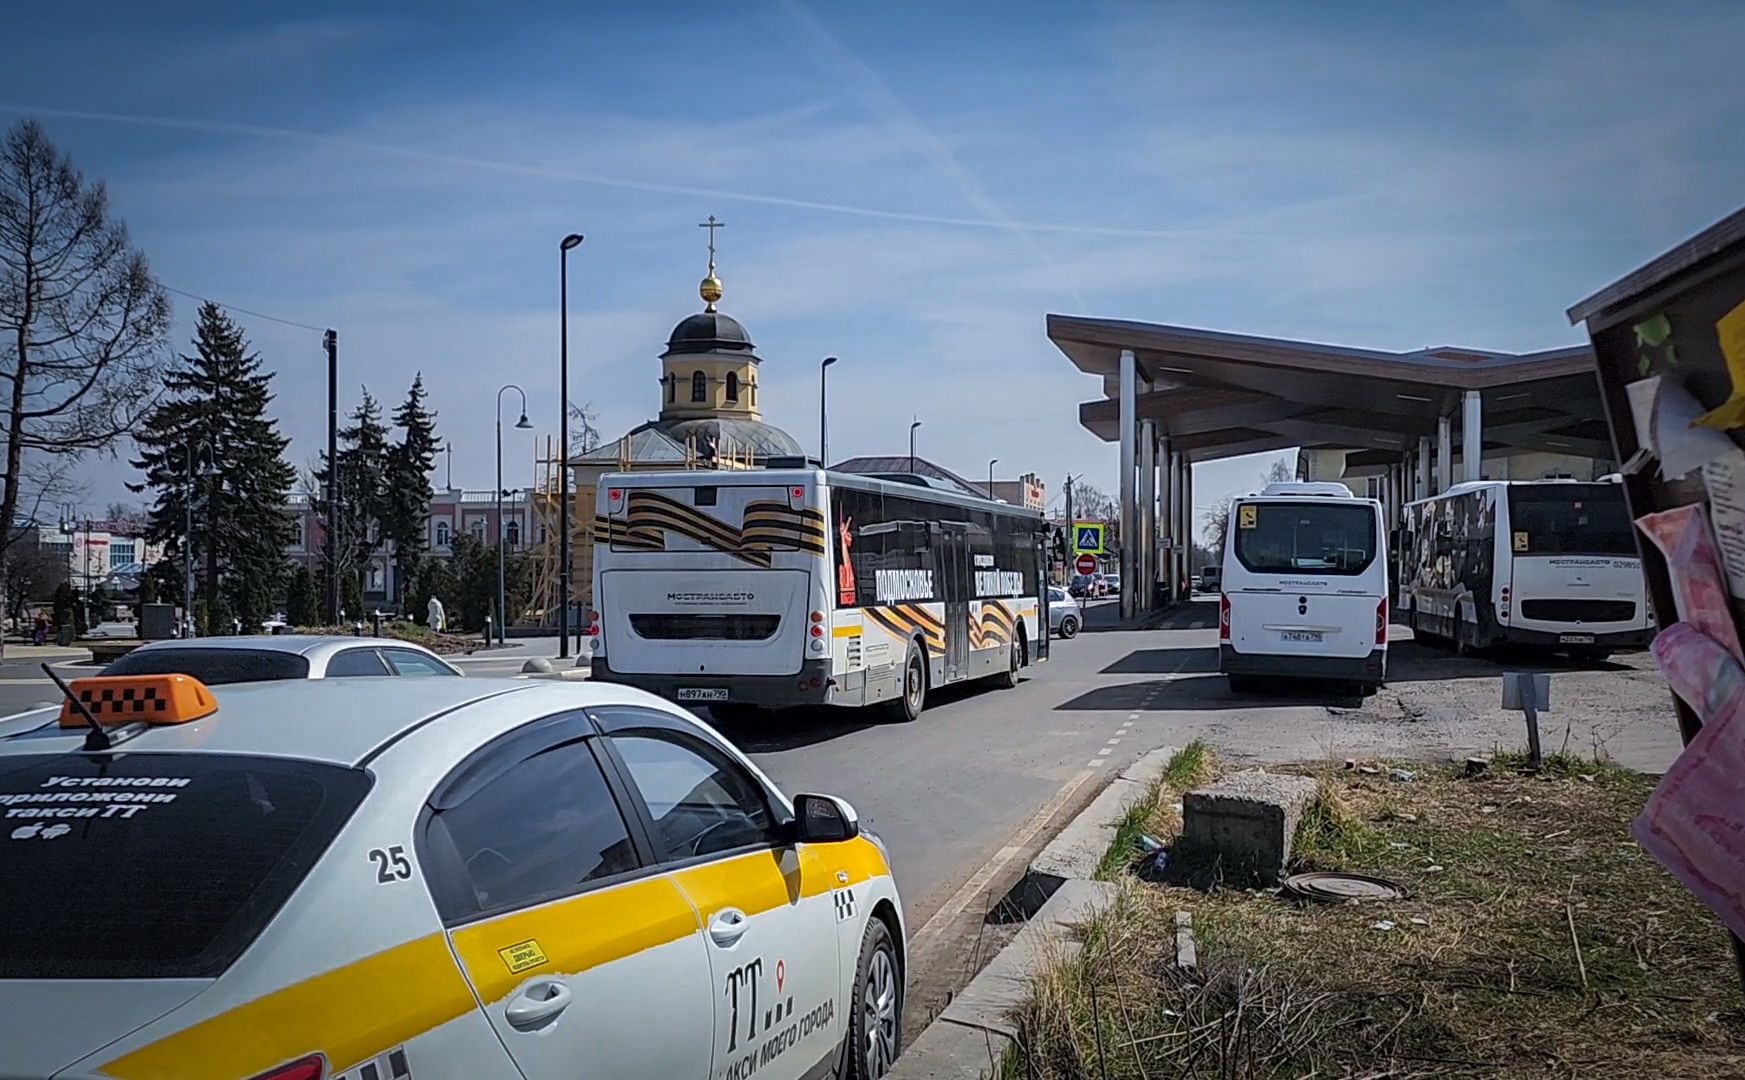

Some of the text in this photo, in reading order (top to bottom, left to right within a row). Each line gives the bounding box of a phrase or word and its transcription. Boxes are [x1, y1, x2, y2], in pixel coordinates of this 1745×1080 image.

[875, 569, 934, 605] ПОДМОСКОВЬЕ
[40, 776, 192, 787] Установи
[5, 807, 100, 818] такси
[368, 845, 412, 885] 25
[719, 998, 834, 1080] АКСИ МОЕГО ГОРОДА
